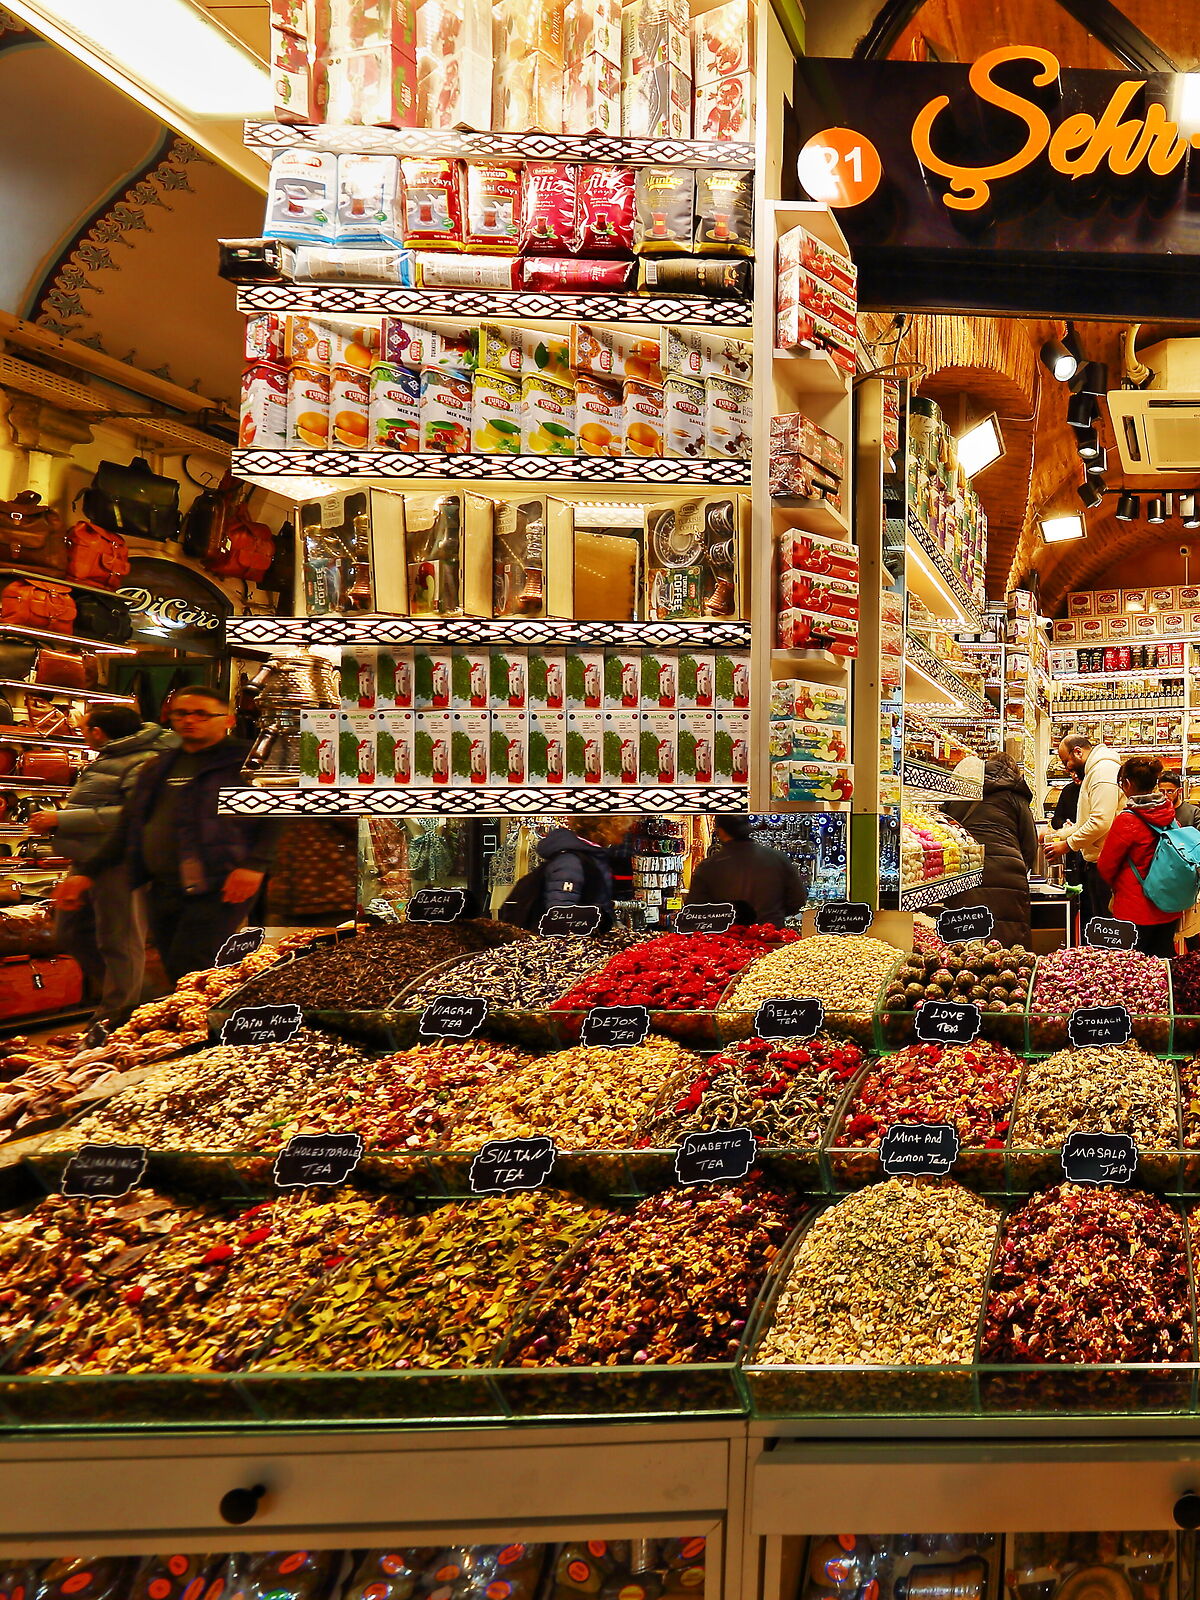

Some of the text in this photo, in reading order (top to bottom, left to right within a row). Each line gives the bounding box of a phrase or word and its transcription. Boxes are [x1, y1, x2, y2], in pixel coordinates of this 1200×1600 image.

[316, 567, 326, 606] COFFEE
[673, 573, 684, 612] COFFEE
[423, 907, 445, 916] TEA
[566, 920, 589, 928] TEA
[695, 922, 713, 931] TEA
[954, 924, 975, 934] TEA
[1093, 923, 1120, 936] ROSE
[1103, 936, 1123, 945] TEA
[431, 1005, 474, 1016] VIAGRA
[766, 1004, 807, 1018] RELAX
[930, 1008, 965, 1021] LOVE
[440, 1018, 463, 1029] TEA
[591, 1016, 639, 1029] DETOX
[250, 1030, 276, 1041] TEA
[610, 1029, 635, 1041] TEA
[1088, 1029, 1111, 1037] TEA
[924, 1131, 942, 1145] And
[686, 1138, 743, 1156] DIABETIC
[1069, 1147, 1127, 1160] MASALA
[74, 1154, 140, 1170] SLIMMING
[480, 1147, 550, 1165] SULTAN
[926, 1152, 949, 1165] Tea
[301, 1163, 332, 1177] TEA
[696, 1159, 725, 1171] TEA
[1099, 1162, 1129, 1177] TEA
[82, 1173, 115, 1188] TEA
[494, 1168, 525, 1184] TEA
